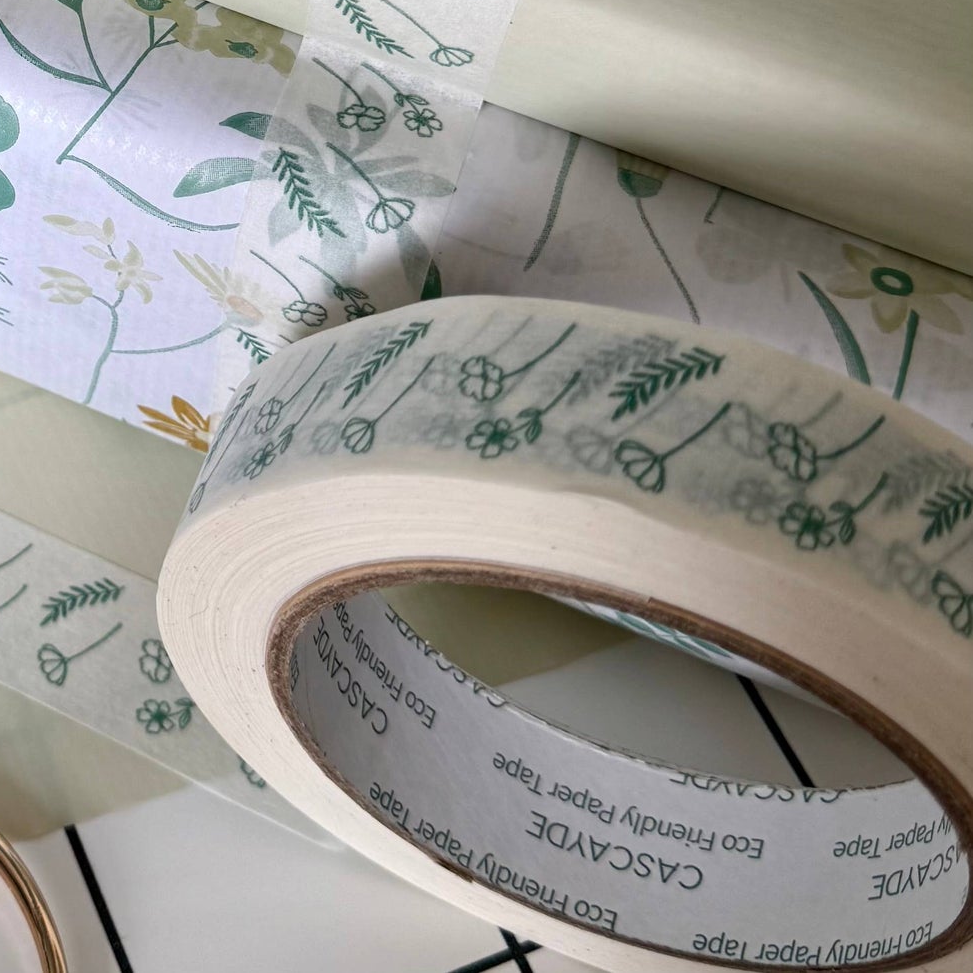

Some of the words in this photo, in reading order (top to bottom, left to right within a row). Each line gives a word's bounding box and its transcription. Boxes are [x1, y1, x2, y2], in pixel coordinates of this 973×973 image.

[312, 615, 389, 736] CASCAYDE
[350, 624, 404, 703] Friendly
[404, 690, 437, 730] Eco
[492, 751, 543, 796] Tape
[369, 781, 413, 838] Tape
[547, 781, 616, 824] Paper
[413, 818, 474, 870] Paper
[525, 810, 704, 891] CASCAYDE
[619, 805, 716, 852] Friendly
[721, 834, 765, 859] Eco
[833, 834, 881, 860] Tape
[885, 820, 936, 852] Paper
[476, 852, 569, 916] Friendly
[574, 899, 619, 934] Eco
[903, 920, 933, 946] Eco
[755, 942, 821, 967] Paper
